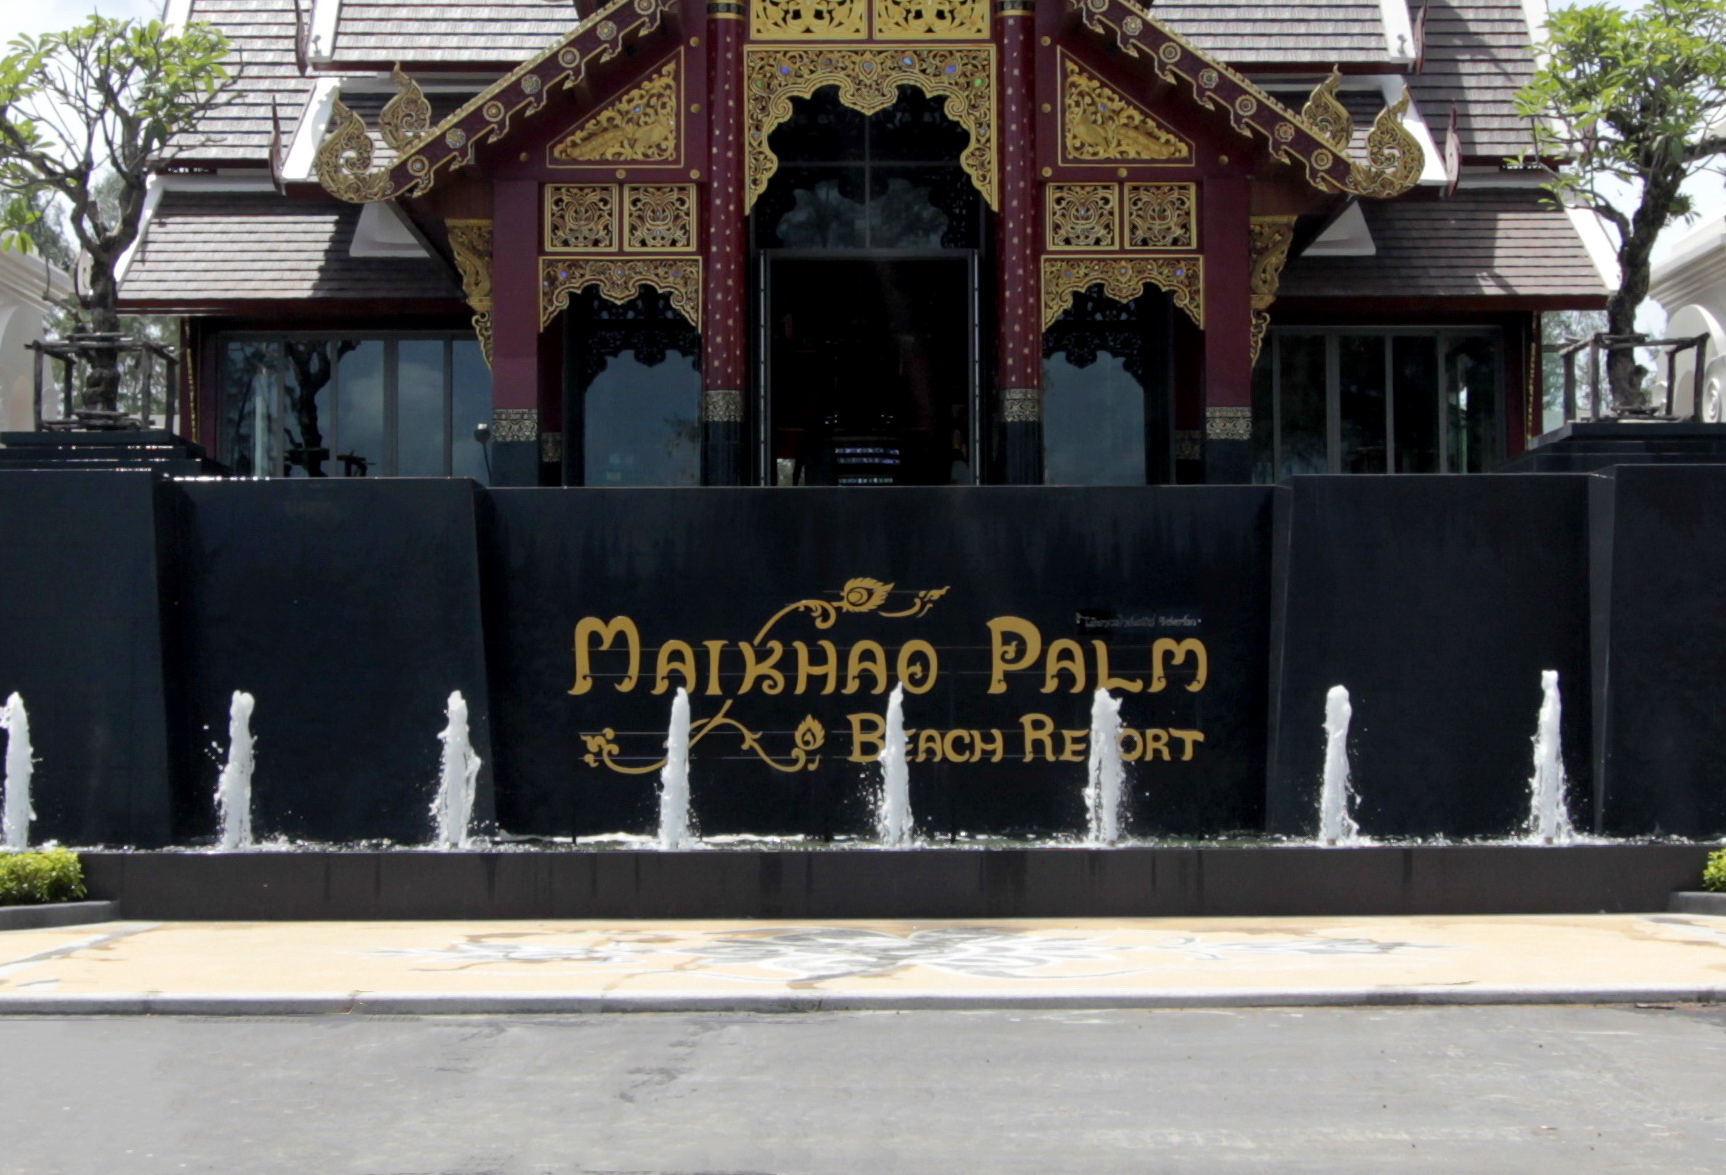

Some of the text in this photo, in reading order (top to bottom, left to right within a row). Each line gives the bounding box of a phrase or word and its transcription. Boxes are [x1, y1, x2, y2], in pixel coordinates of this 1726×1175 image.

[568, 615, 1208, 694] MAIKHAO PALM
[1018, 712, 1205, 763] REORT
